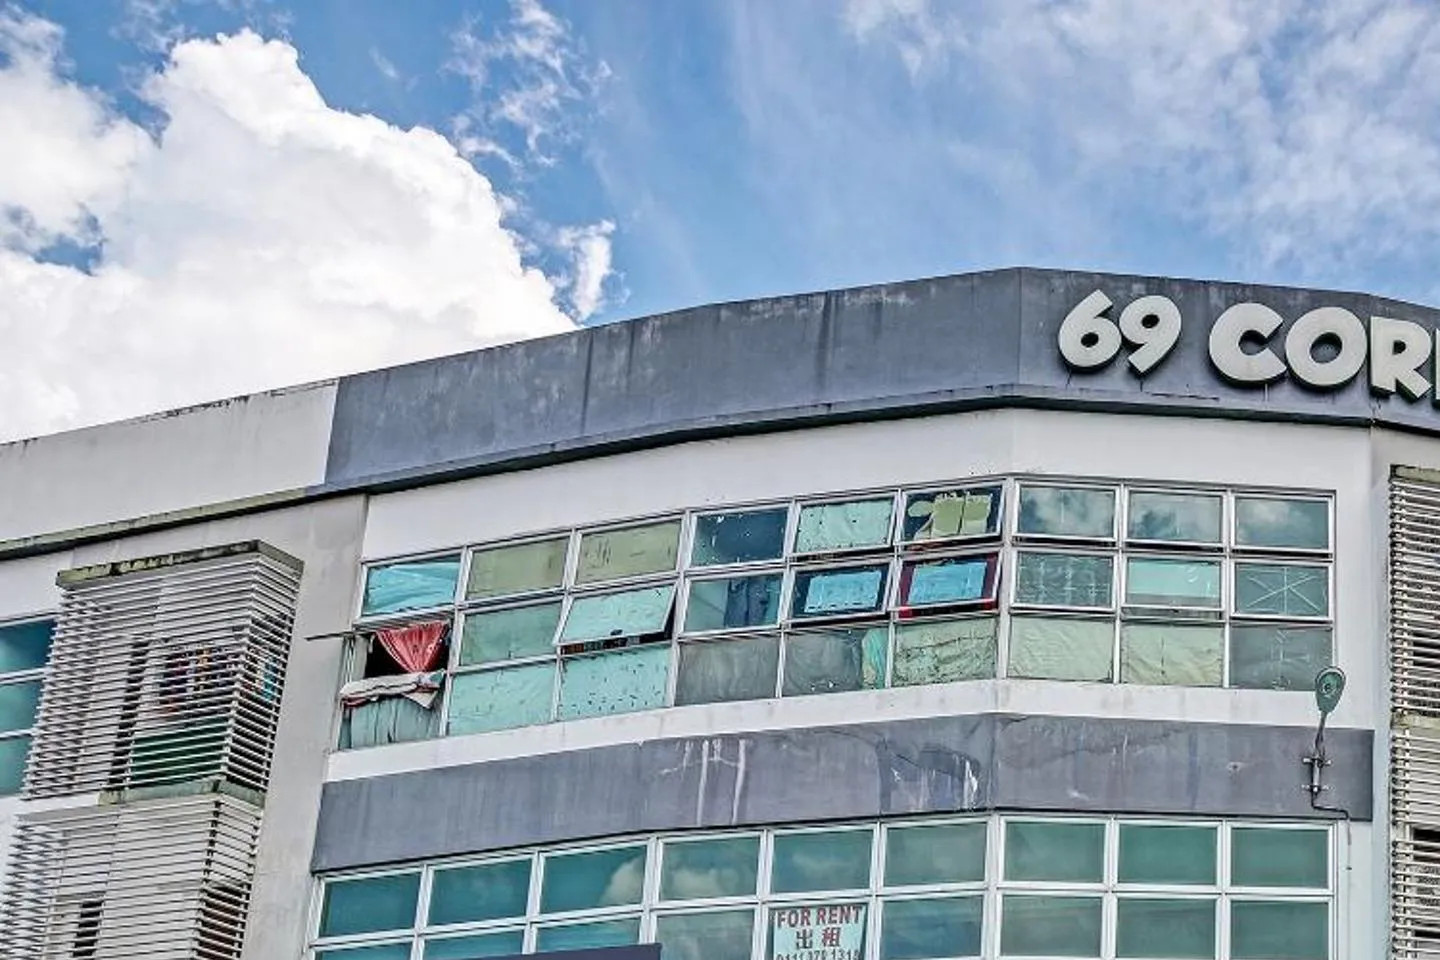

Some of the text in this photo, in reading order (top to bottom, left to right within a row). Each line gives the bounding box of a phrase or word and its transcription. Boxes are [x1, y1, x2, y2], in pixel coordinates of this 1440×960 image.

[1057, 289, 1182, 376] 69
[776, 904, 863, 928] FOR RENT
